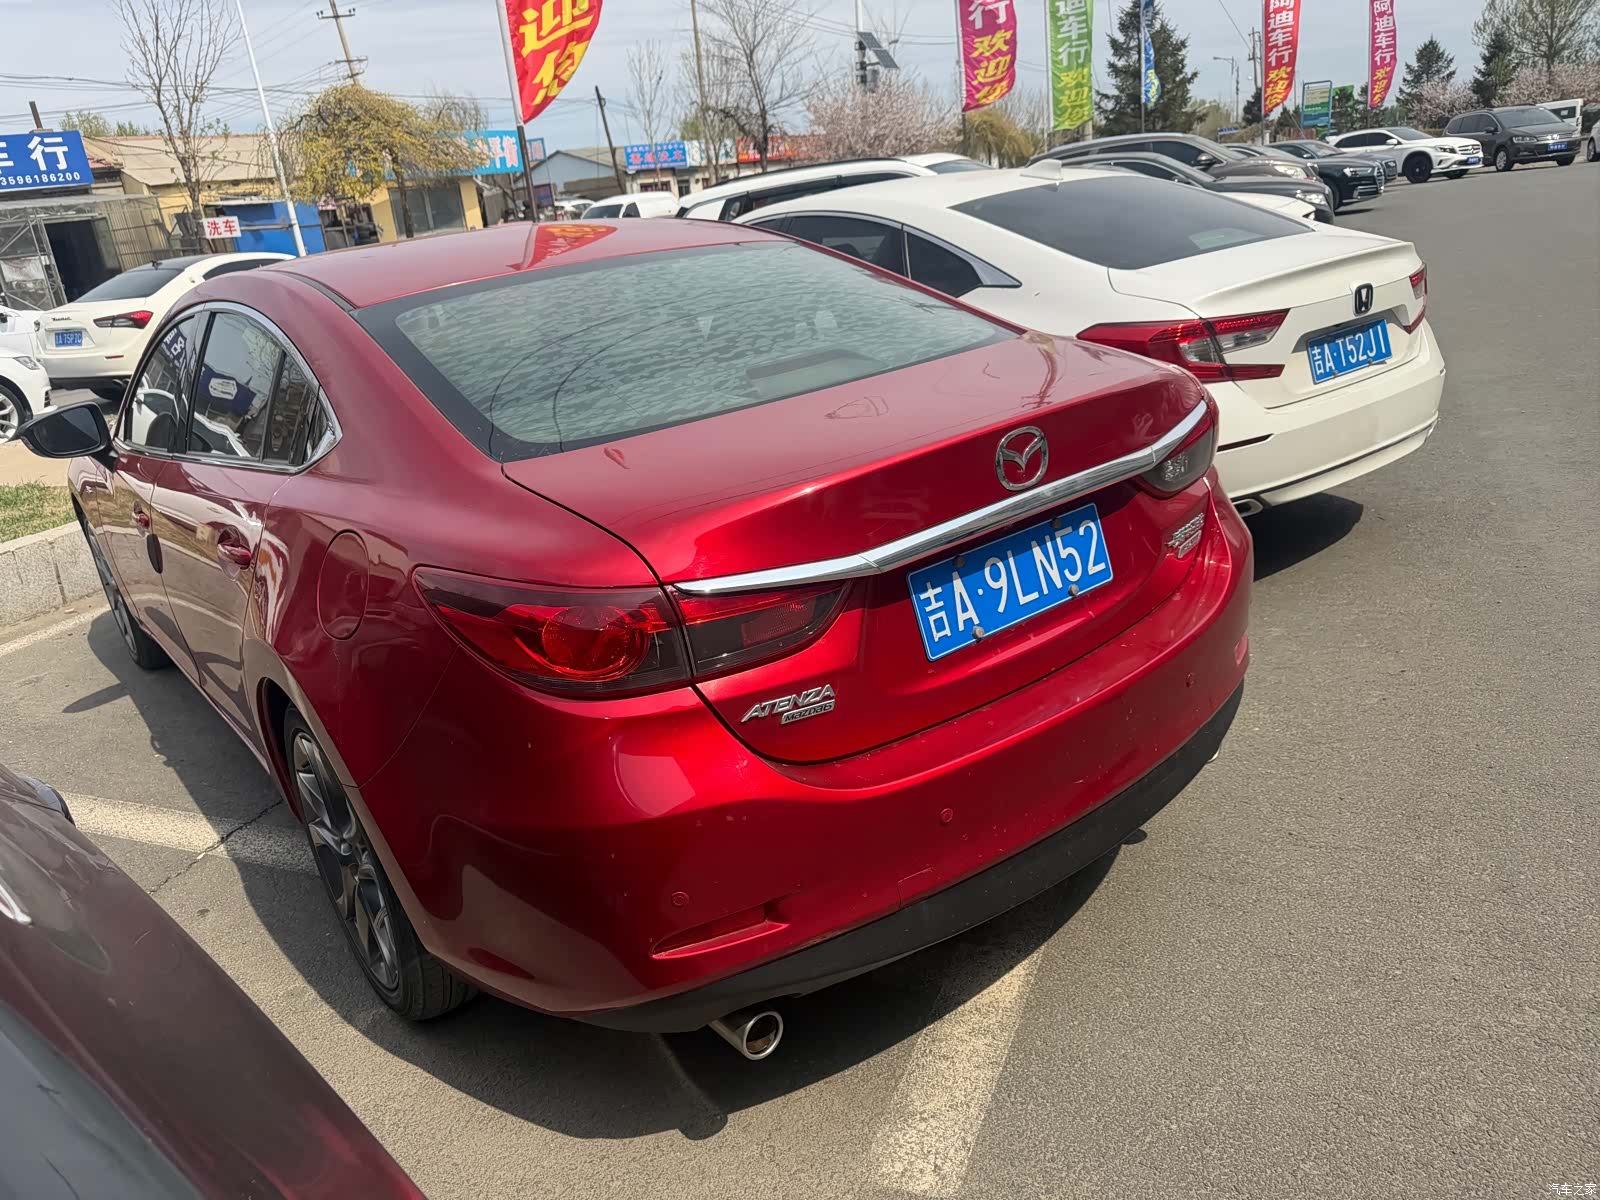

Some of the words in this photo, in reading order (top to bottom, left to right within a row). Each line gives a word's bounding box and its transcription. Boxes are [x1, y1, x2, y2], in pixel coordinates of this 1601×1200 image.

[206, 219, 238, 237] 洗车
[919, 519, 1106, 642] 吉A·9LN52
[741, 684, 835, 722] ATENZA
